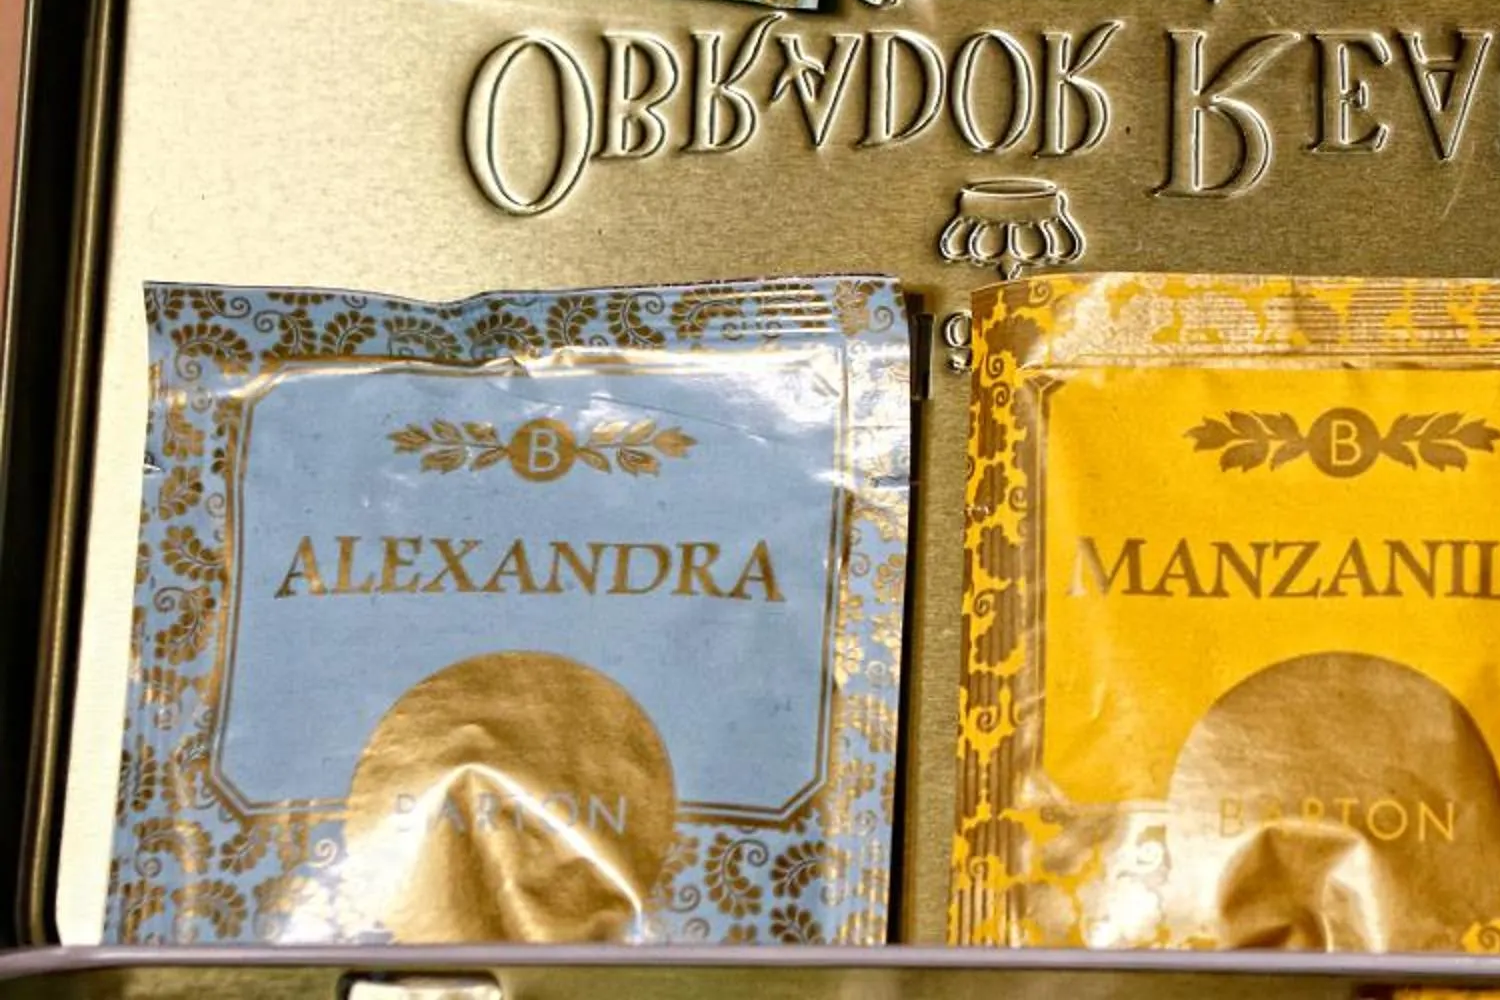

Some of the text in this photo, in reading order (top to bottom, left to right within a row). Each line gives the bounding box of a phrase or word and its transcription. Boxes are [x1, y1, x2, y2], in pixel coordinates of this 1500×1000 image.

[528, 429, 560, 472] B
[1331, 420, 1361, 467] B
[274, 535, 786, 603] ALEXANDRA
